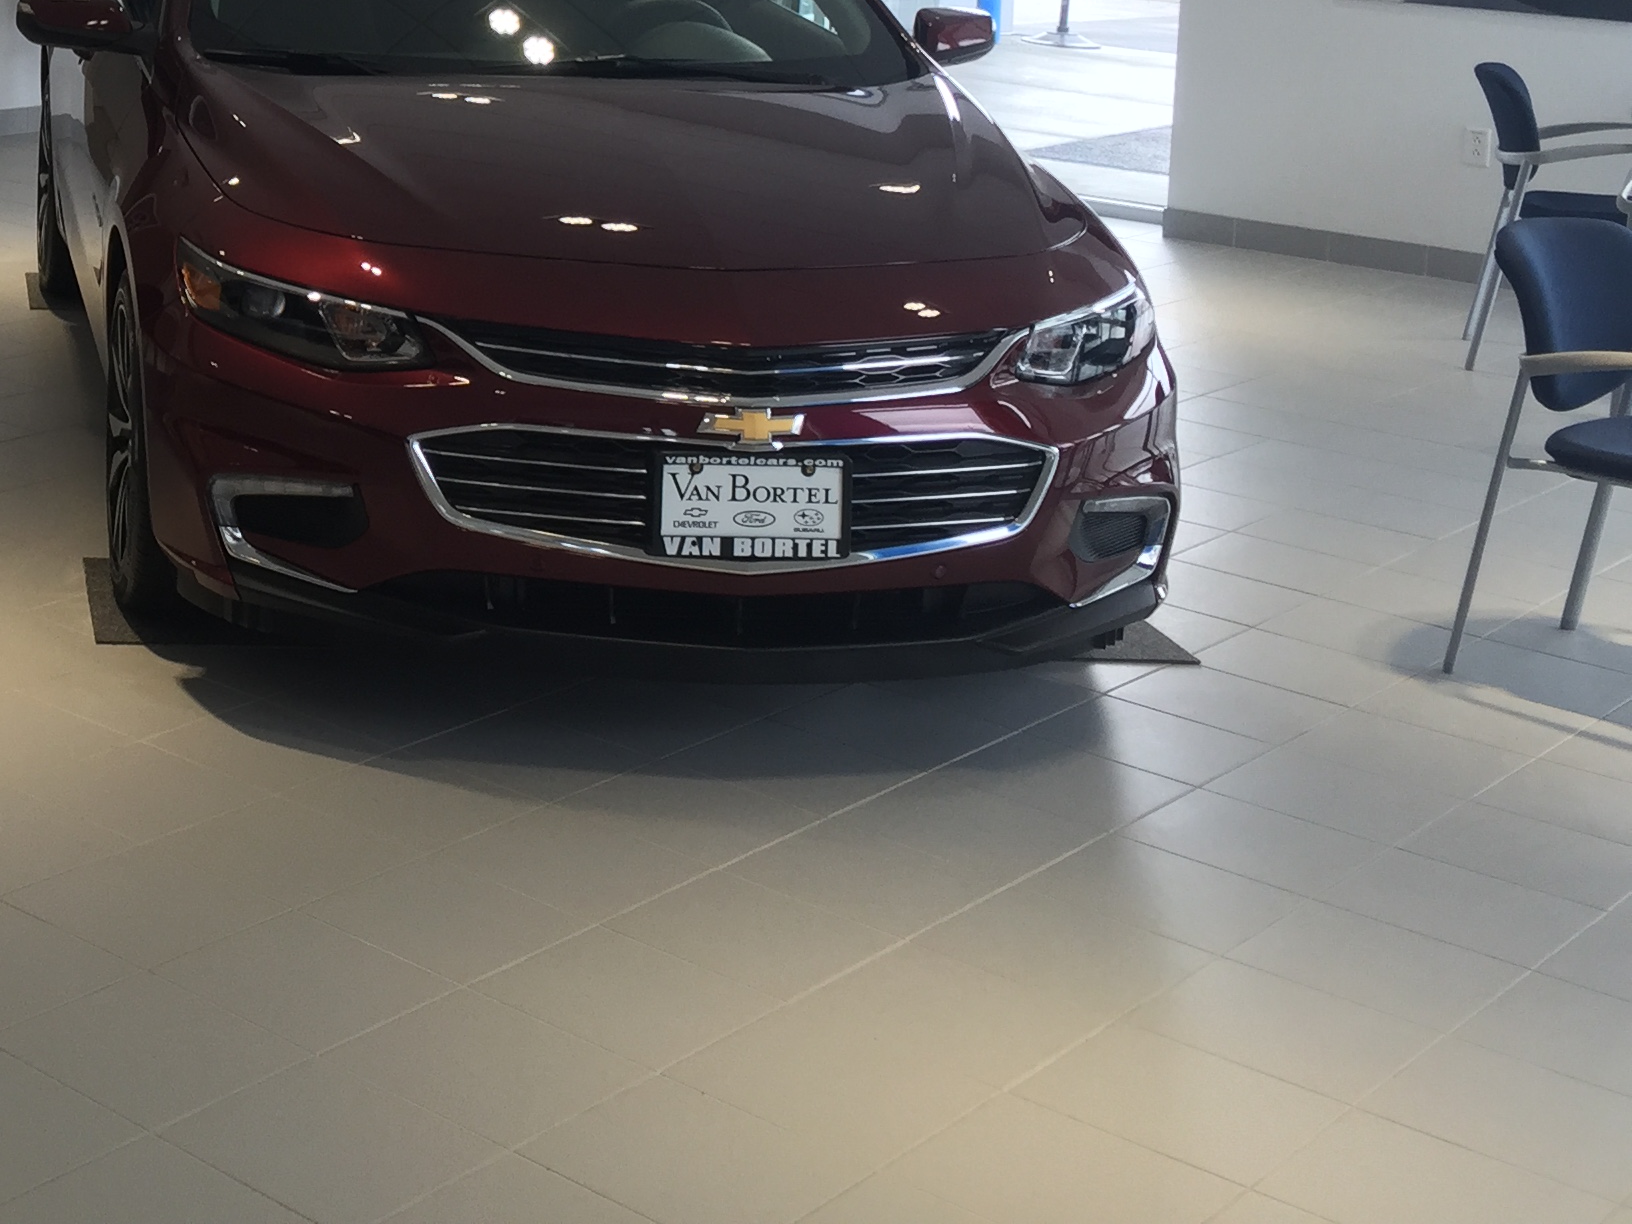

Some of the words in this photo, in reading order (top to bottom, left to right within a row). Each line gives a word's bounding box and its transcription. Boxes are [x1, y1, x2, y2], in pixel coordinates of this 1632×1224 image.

[665, 455, 844, 467] vanbortelcars.com
[727, 473, 839, 505] BORTEL
[673, 520, 718, 528] CHEVROLET
[741, 513, 767, 524] Ford
[663, 537, 721, 556] VAN
[733, 538, 841, 558] BORTEL
